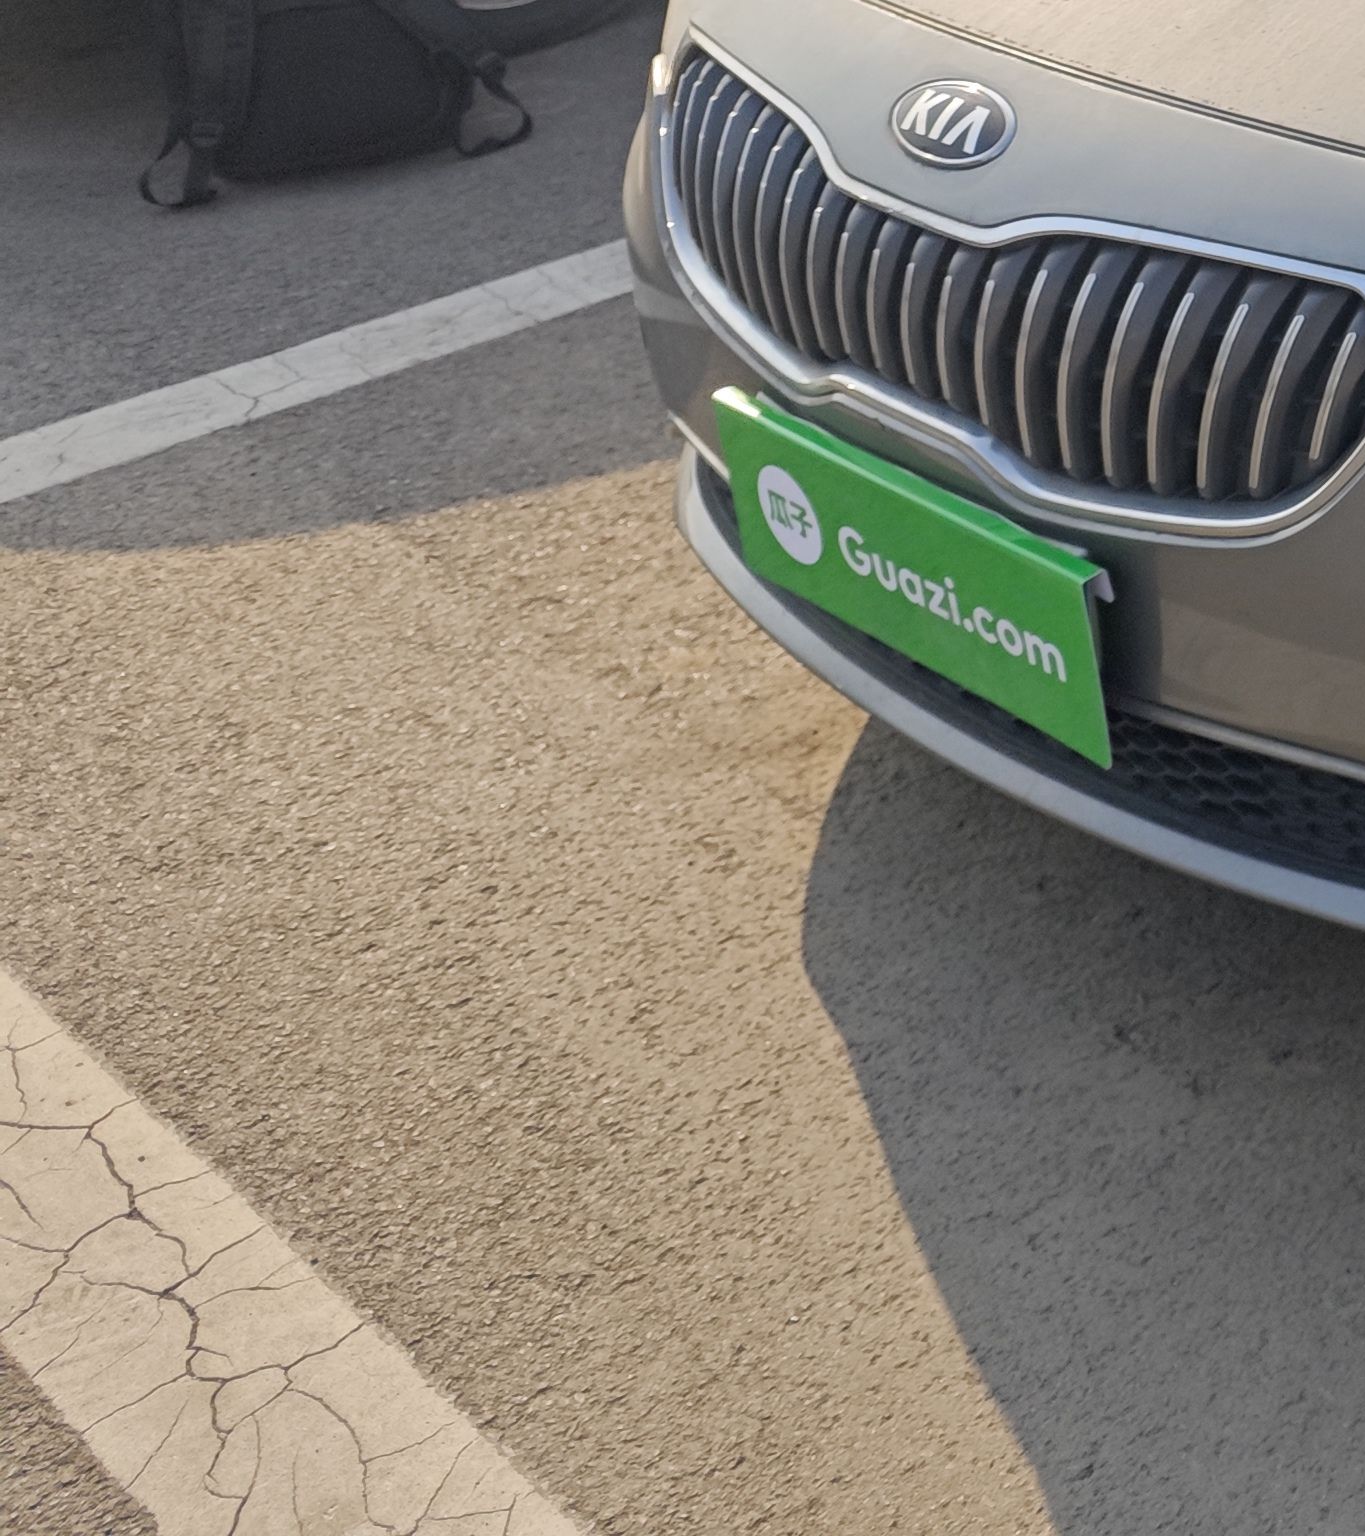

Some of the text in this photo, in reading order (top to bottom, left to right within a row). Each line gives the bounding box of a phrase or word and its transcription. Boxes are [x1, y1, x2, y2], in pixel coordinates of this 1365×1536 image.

[900, 88, 991, 155] KIA
[767, 488, 813, 539] 瓜子
[838, 525, 1067, 683] Guazi.com
